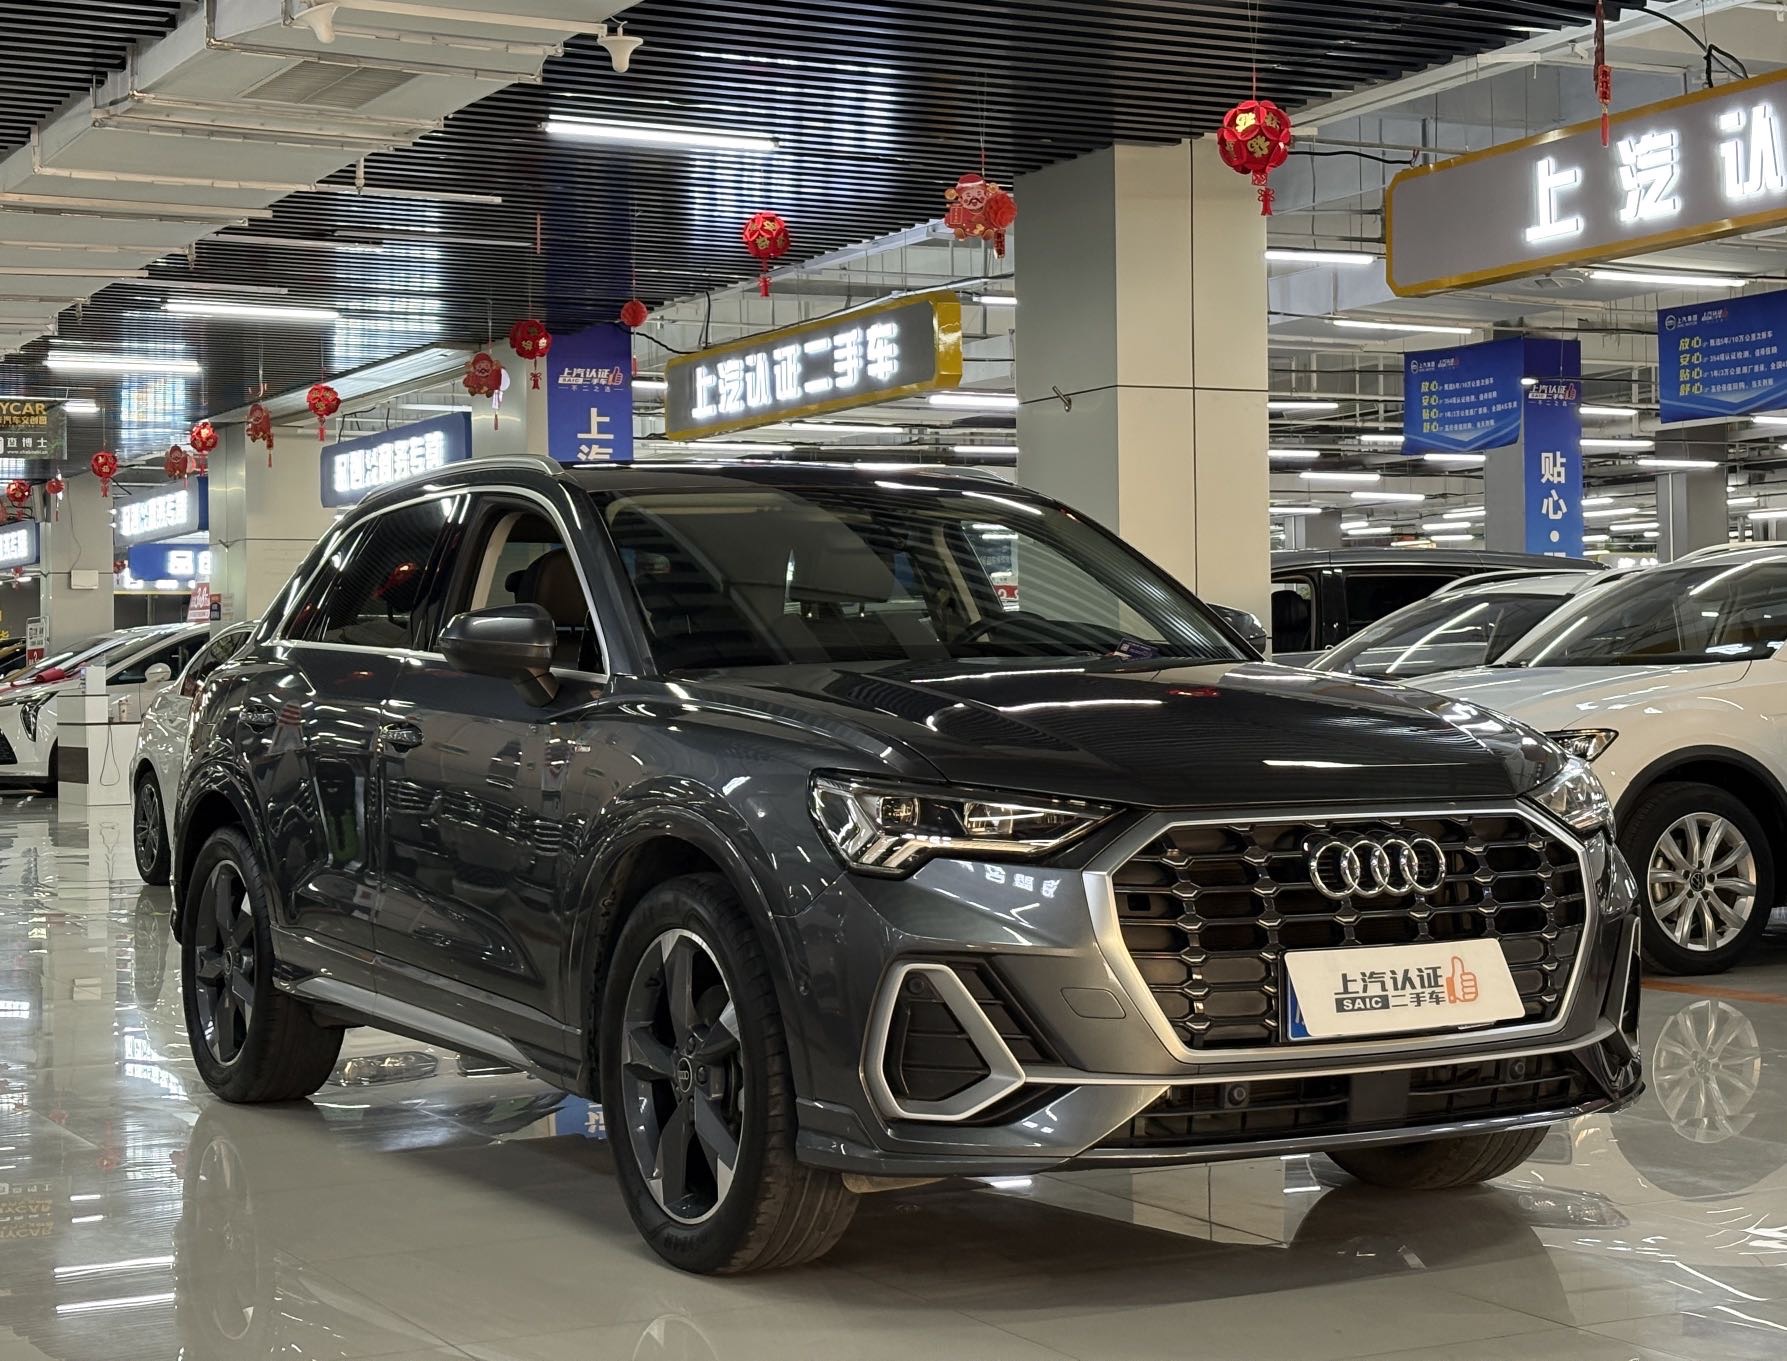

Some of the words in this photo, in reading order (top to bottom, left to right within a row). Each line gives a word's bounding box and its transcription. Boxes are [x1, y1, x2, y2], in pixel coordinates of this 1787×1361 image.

[1526, 105, 1787, 242] 上汽认
[1679, 336, 1701, 351] 放心
[1680, 352, 1702, 366] 安心
[560, 367, 611, 379] 上汽认证
[691, 322, 899, 420] 上汽认证二手车
[1680, 367, 1703, 381] 贴心
[0, 402, 47, 415] YCAR
[7, 437, 48, 448] 查博士
[1334, 965, 1444, 996] 上汽认证
[1343, 998, 1383, 1010] SAIC
[1391, 990, 1446, 1008] 二手车
